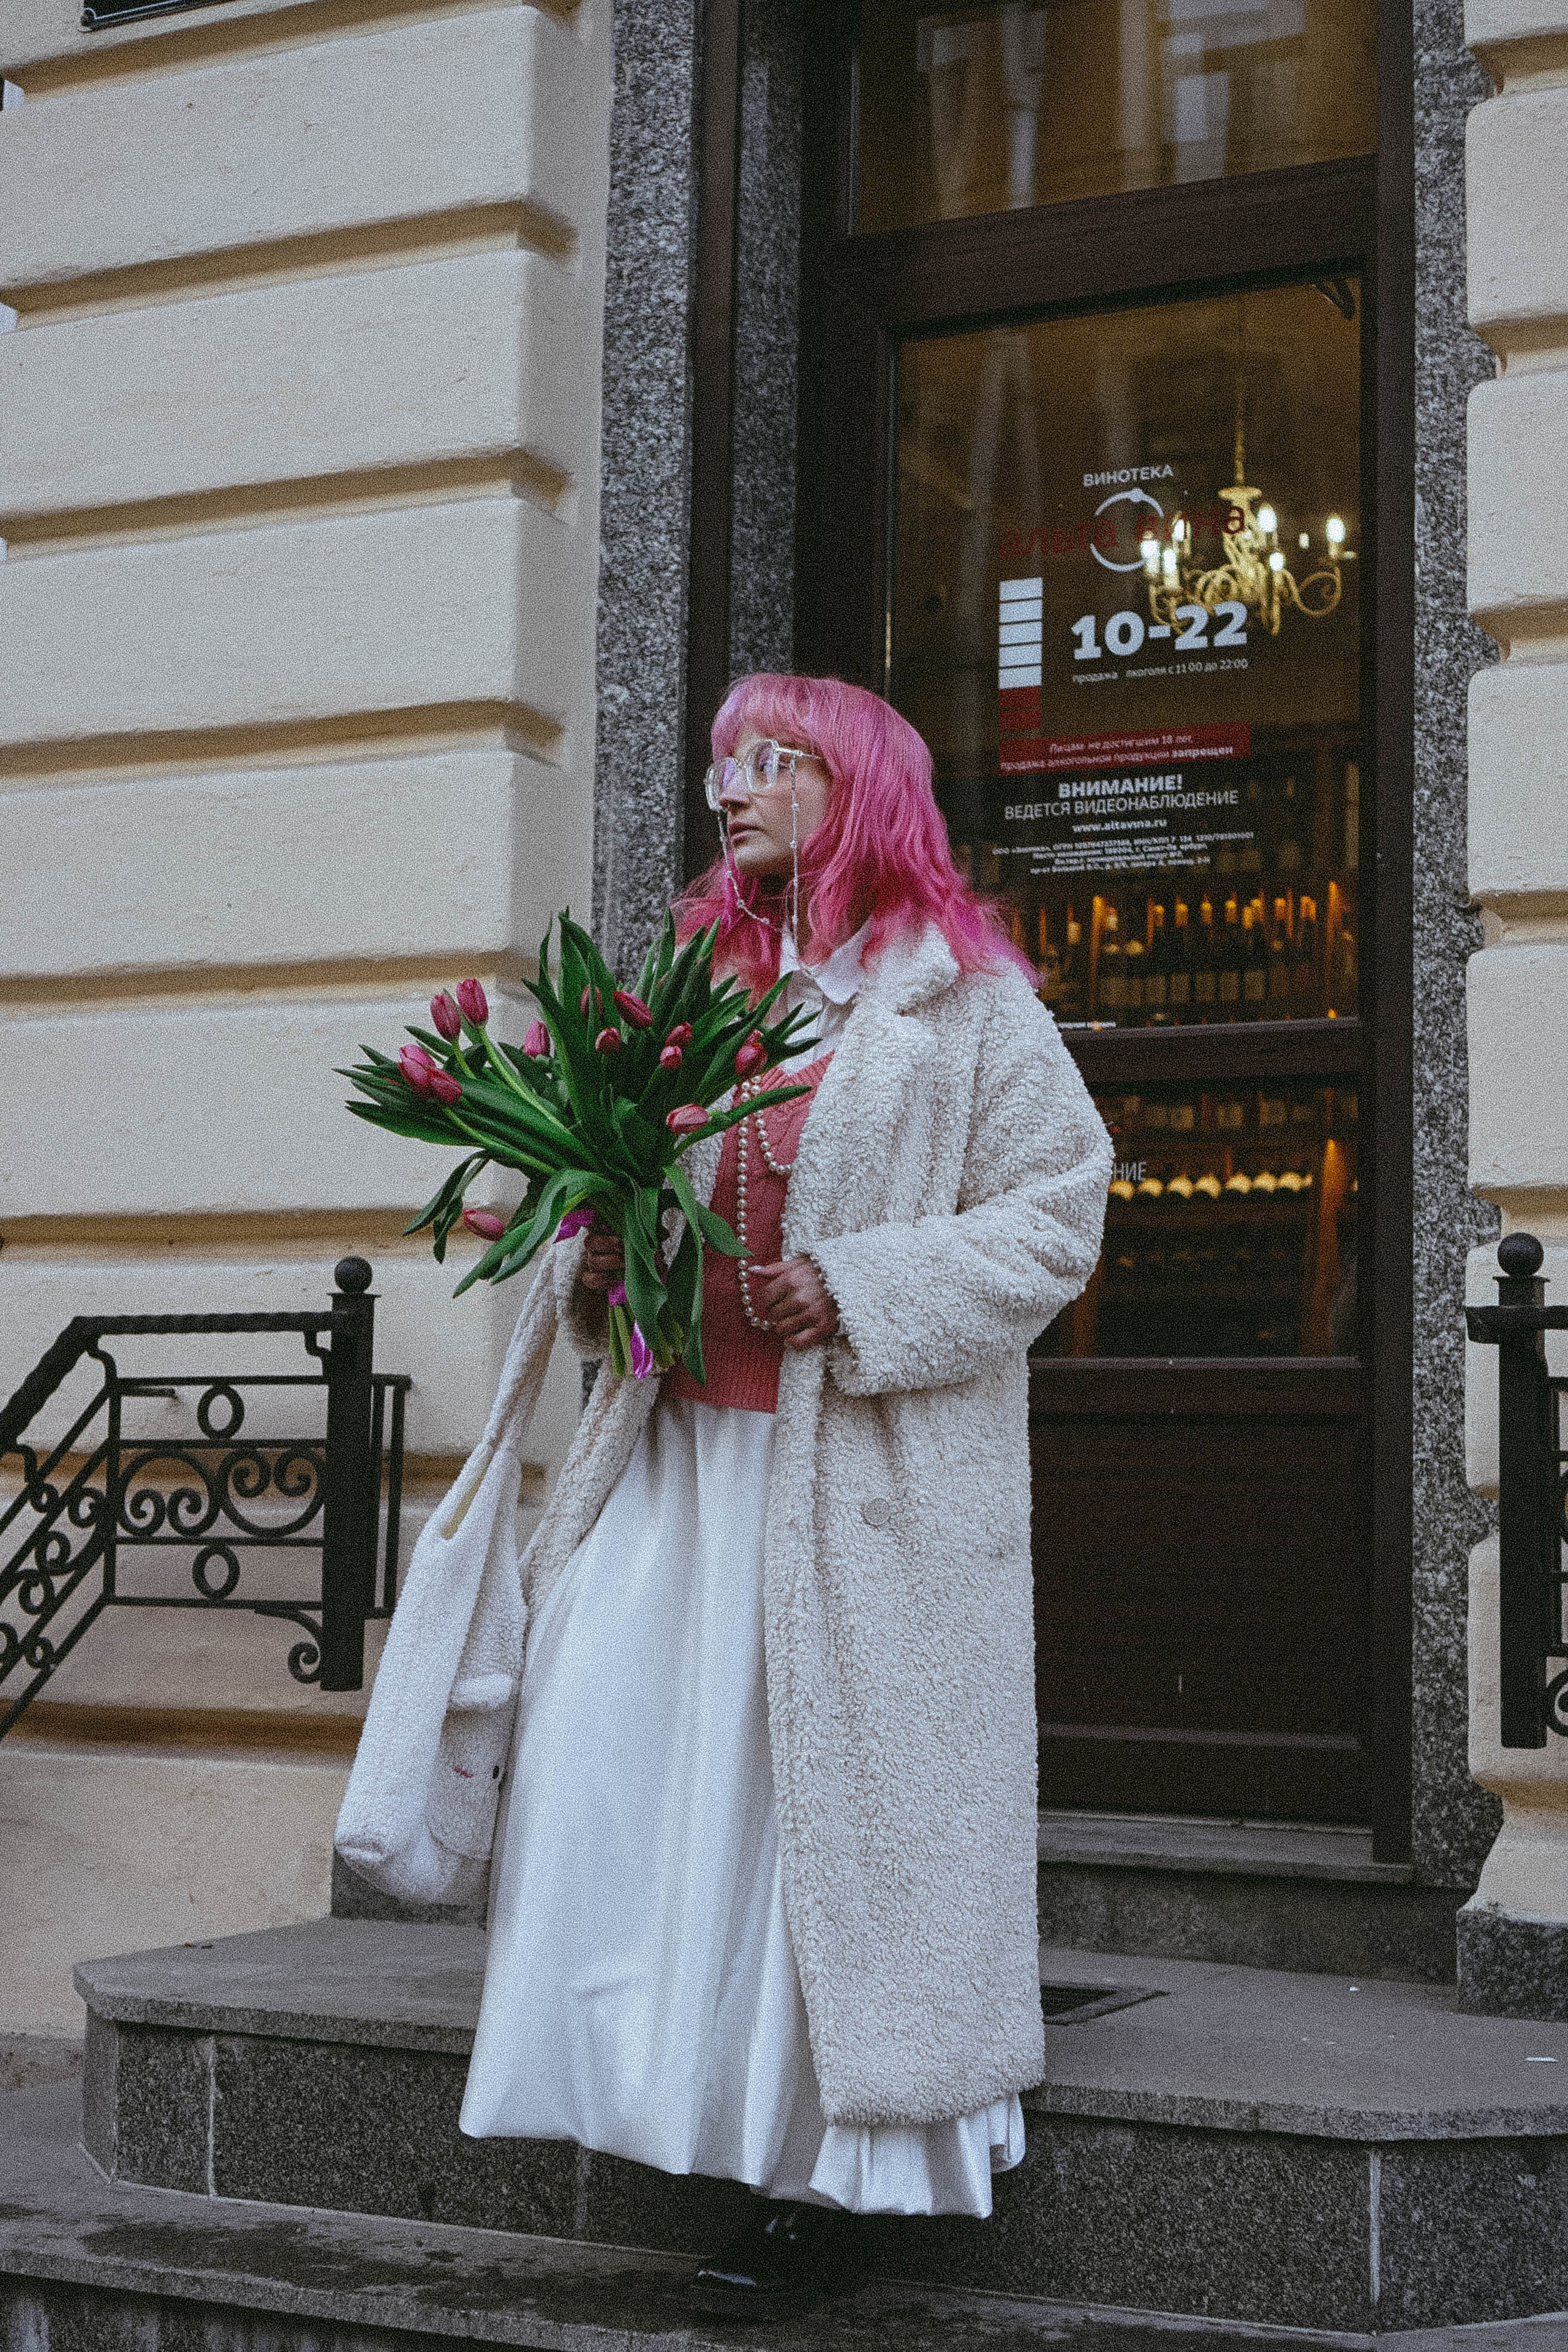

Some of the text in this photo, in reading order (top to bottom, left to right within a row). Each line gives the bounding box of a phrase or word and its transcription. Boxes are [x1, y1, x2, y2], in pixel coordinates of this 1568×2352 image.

[1083, 464, 1174, 487] ВИНОТЕКА
[1072, 601, 1248, 660] 10-22
[1161, 735, 1173, 745] 18
[1058, 774, 1183, 798] ВНИМАНИЕ!
[1005, 790, 1238, 820] ВЕДЕТСЯ ВИДЕОНАБЛЮДЕНИЕ
[1072, 819, 1167, 833] www.altavina.ru
